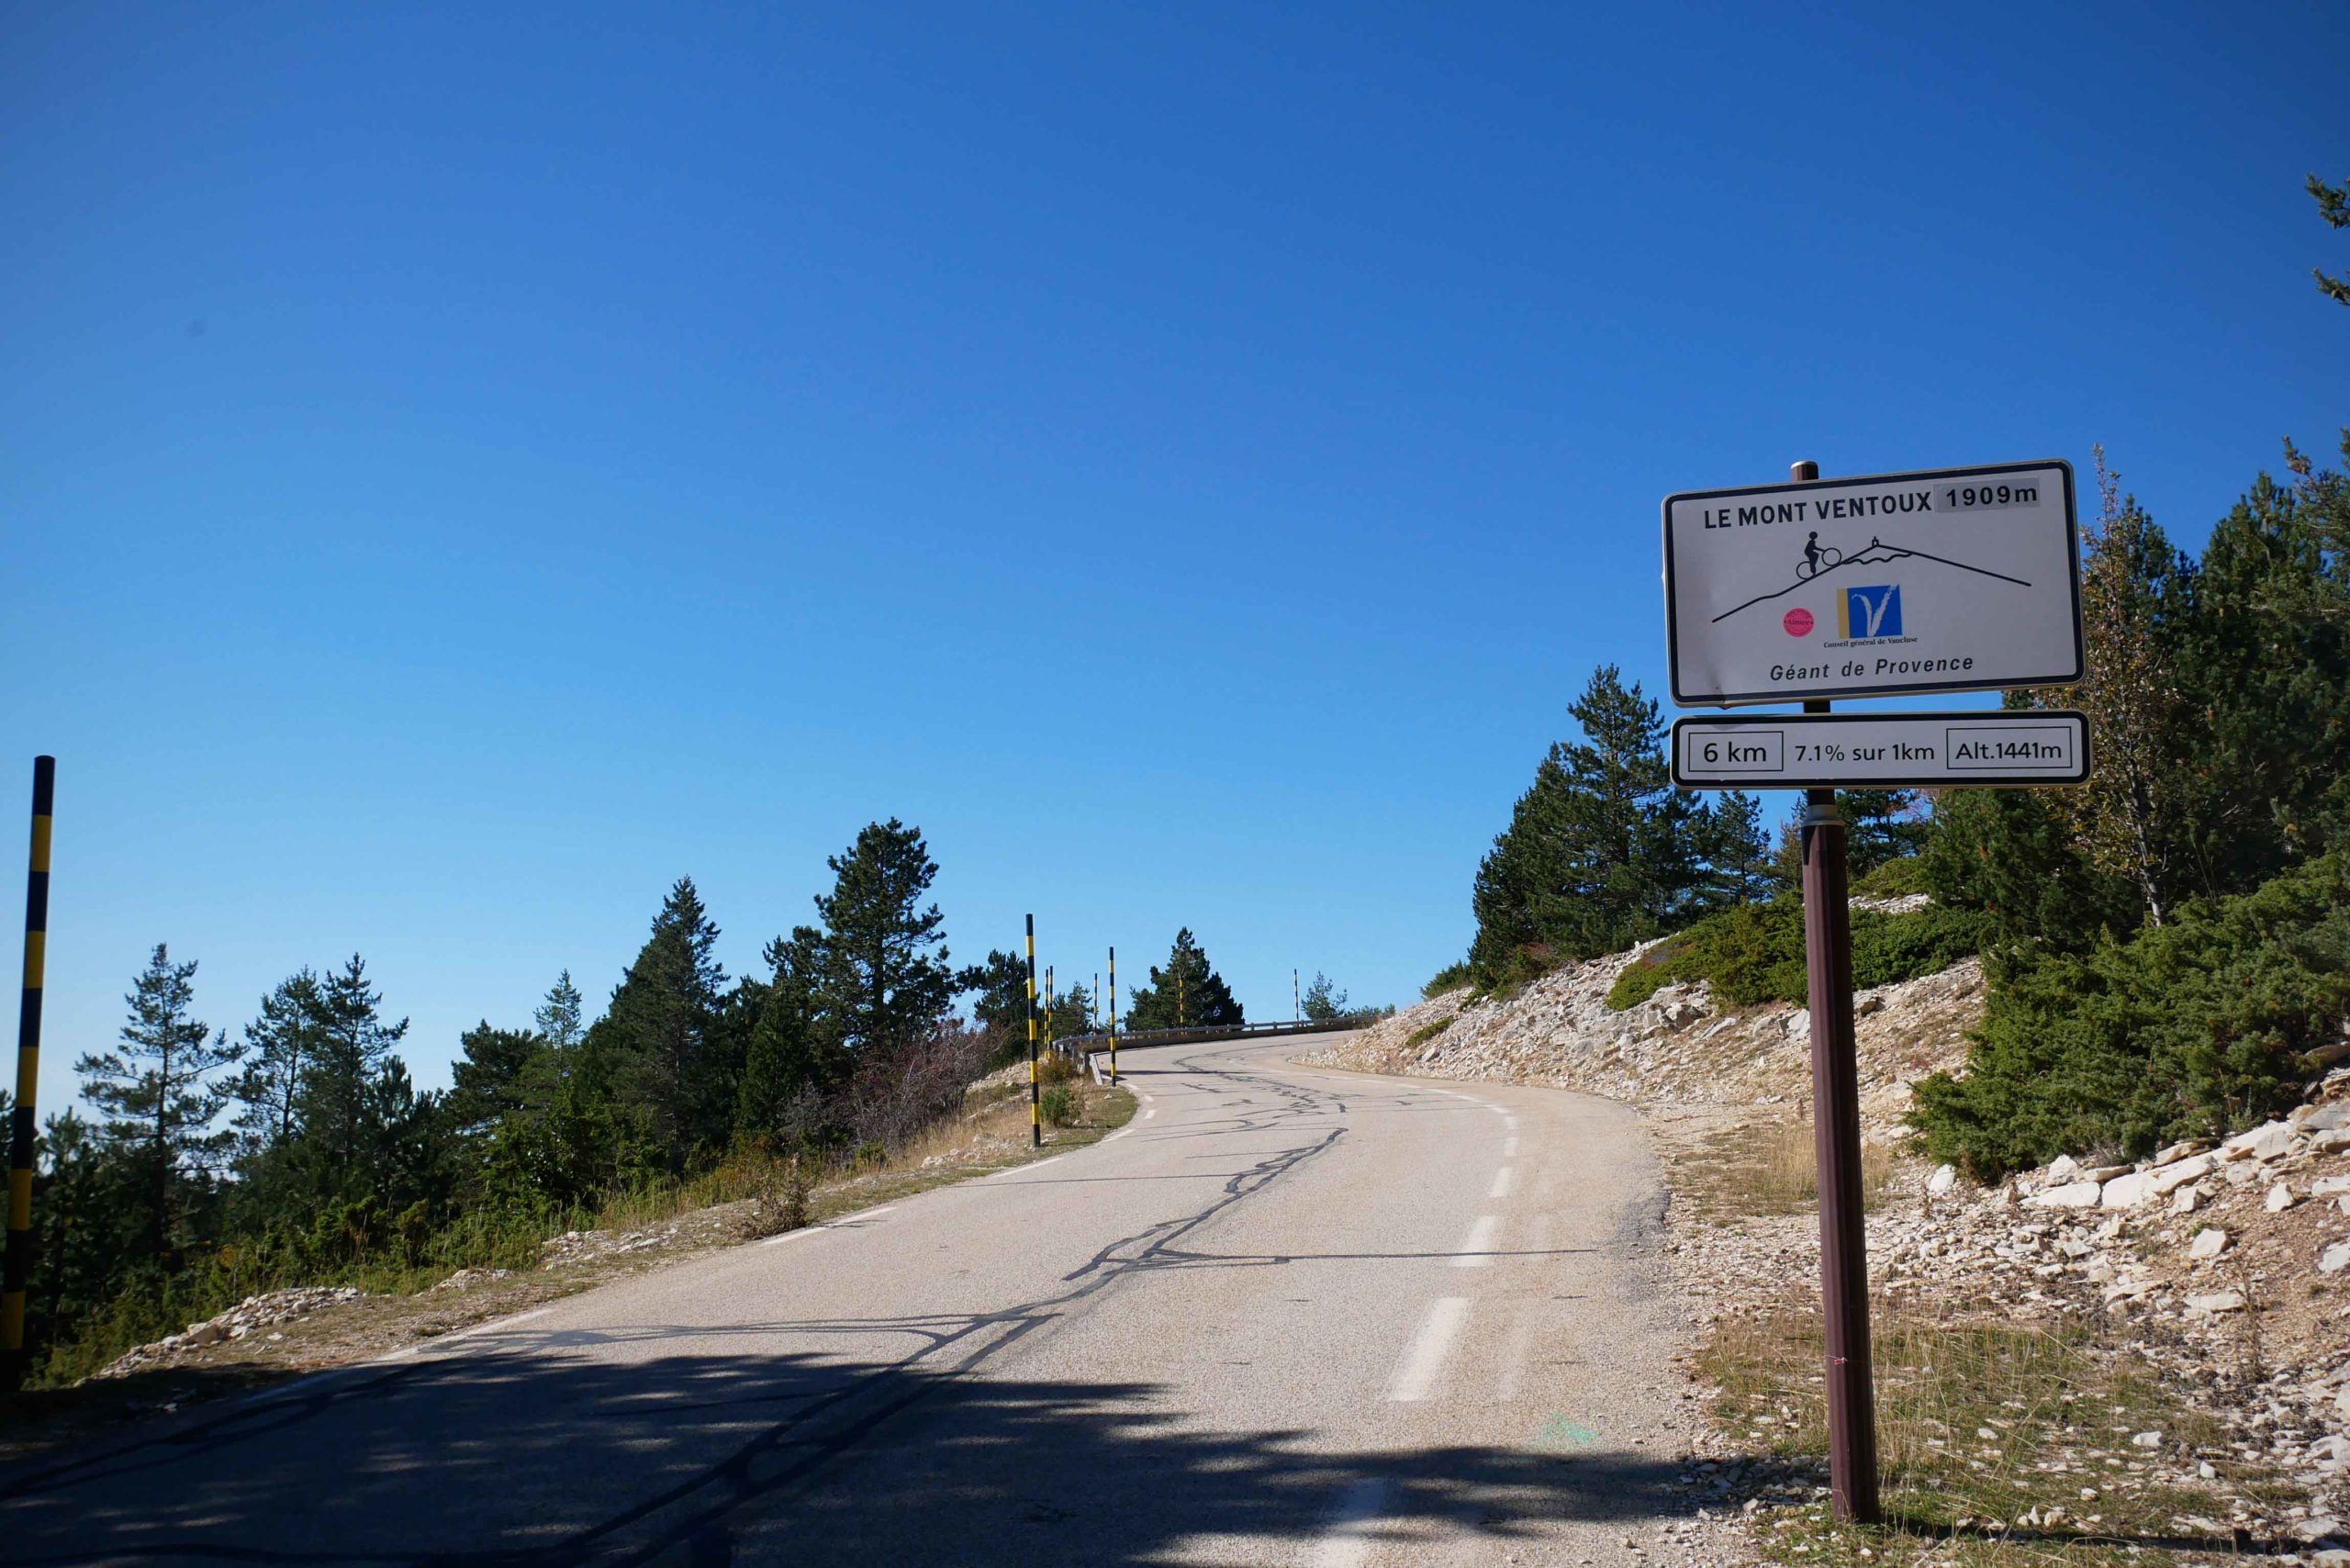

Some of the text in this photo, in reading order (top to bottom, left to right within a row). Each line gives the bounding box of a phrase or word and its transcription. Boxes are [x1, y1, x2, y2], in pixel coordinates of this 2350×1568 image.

[1704, 485, 2038, 529] LE MONT VENTOUX 1909m
[1823, 636, 1919, 648] Conseil général de Vaucluse
[1770, 655, 1974, 681] Géant de Provence
[1703, 742, 1719, 763] 6
[1728, 742, 1767, 762] km
[1795, 745, 1845, 762] 7.1%
[1852, 745, 1886, 761] sur
[1893, 742, 1935, 761] 1km
